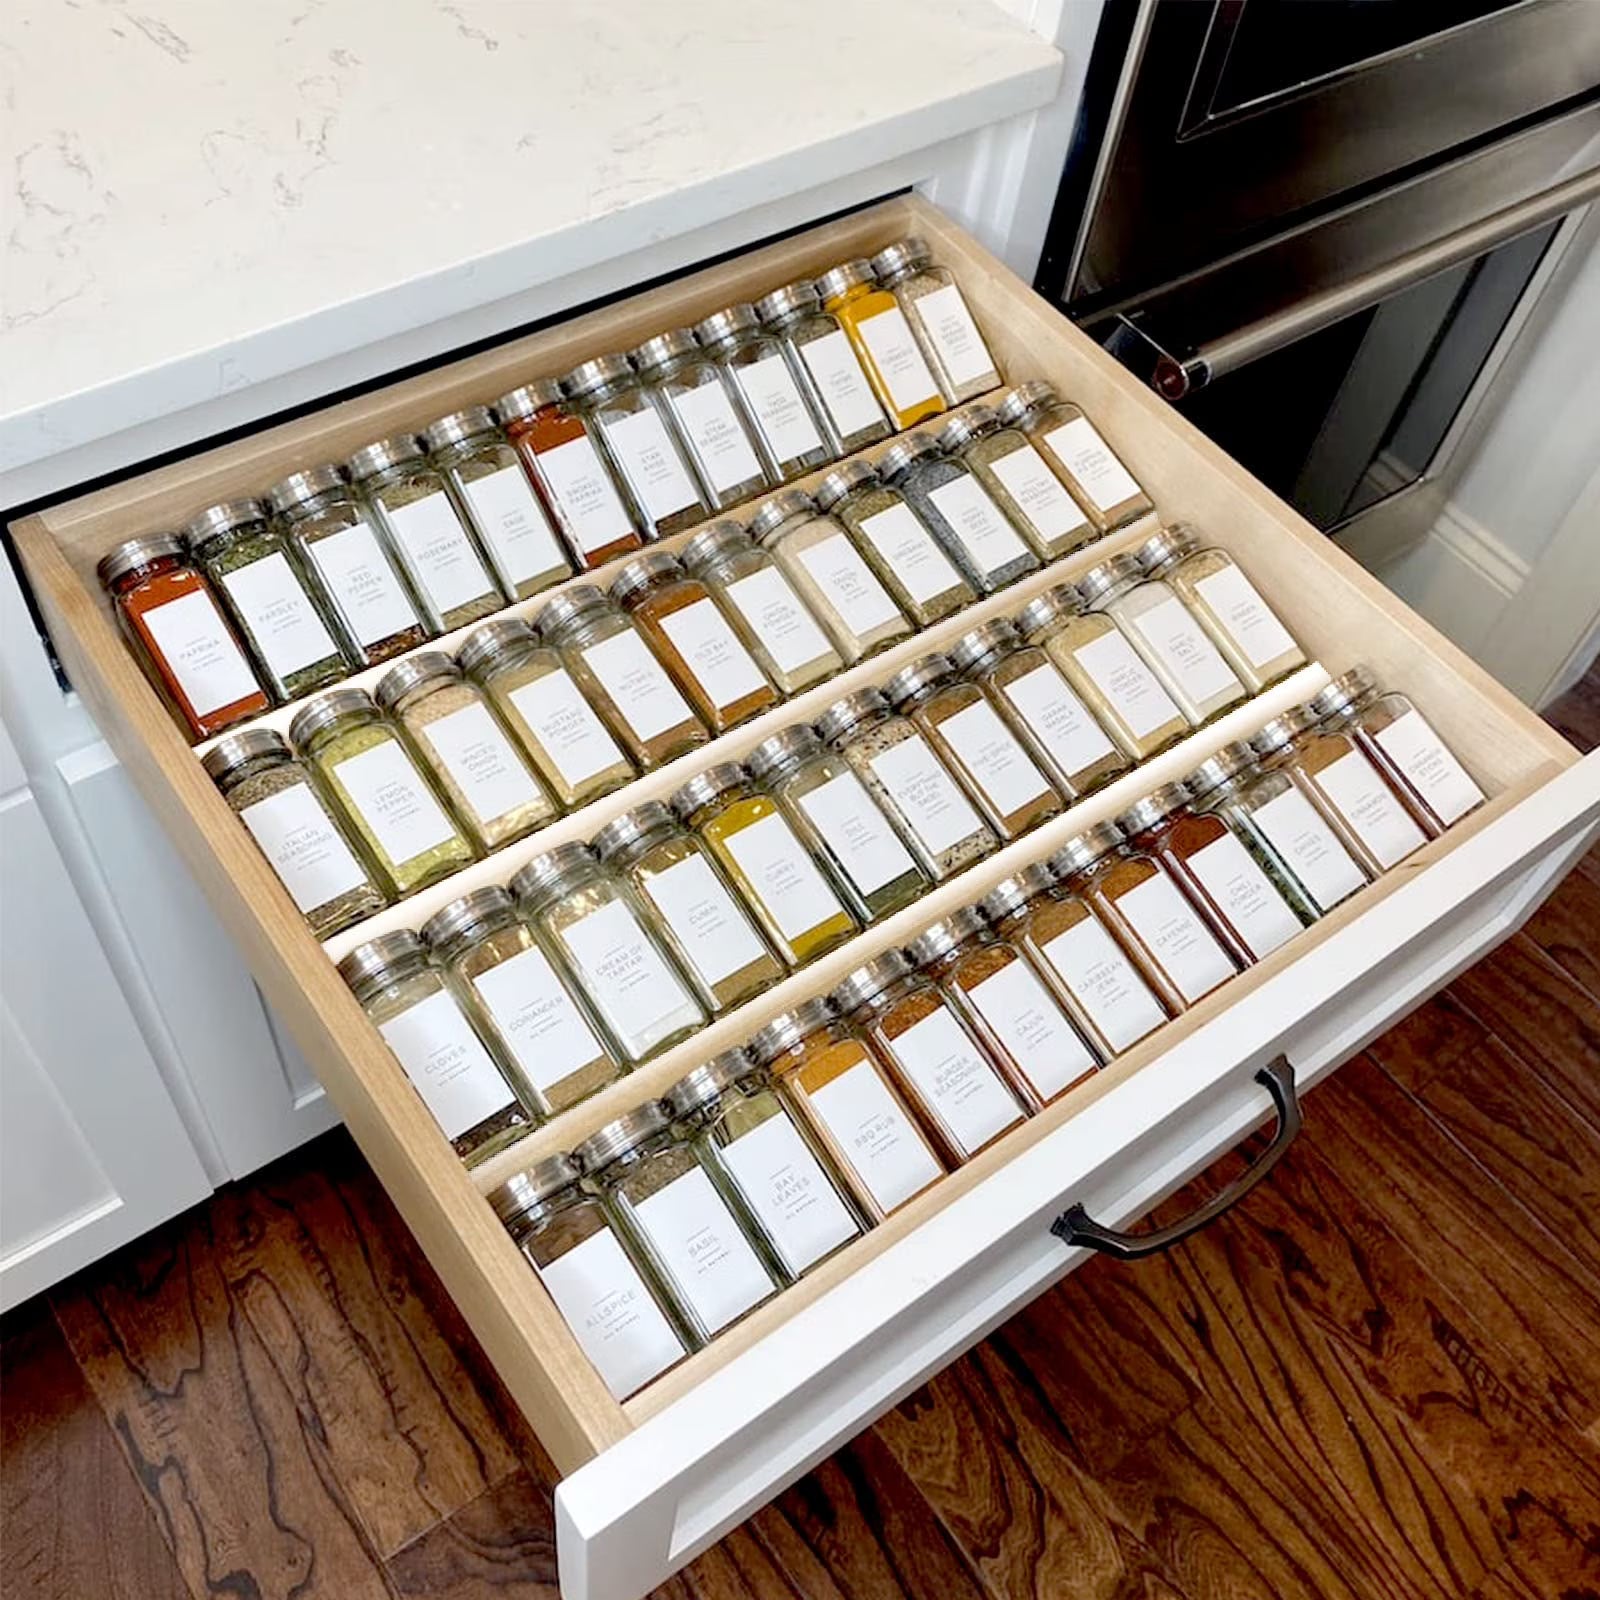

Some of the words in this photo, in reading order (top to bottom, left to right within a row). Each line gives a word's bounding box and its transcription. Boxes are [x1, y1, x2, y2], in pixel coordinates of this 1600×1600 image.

[416, 536, 464, 562] ROSEMARY
[347, 575, 383, 595] PEPPER
[351, 570, 372, 584] RED
[257, 598, 301, 624] PARSLEY
[547, 715, 587, 741] POWDER
[373, 783, 410, 807] LEMON
[376, 790, 416, 815] PEPPER
[276, 831, 334, 864] SEASONING
[281, 828, 320, 851] ITALIAN
[1154, 919, 1193, 949] CAYENNE
[594, 950, 631, 977] CREAM
[604, 953, 645, 982] TARTAR
[1075, 958, 1124, 995] CARIBBEAN
[507, 994, 566, 1033] CORIANDER
[1014, 1012, 1046, 1039] CAJUN
[423, 1044, 467, 1076] CLOVES
[933, 1056, 971, 1087] BURGER
[932, 1059, 983, 1099] SEASONING
[853, 1128, 878, 1150] BBQ
[872, 1114, 897, 1136] RUB
[769, 1175, 812, 1208] LEAVES
[773, 1172, 796, 1192] BAY
[686, 1231, 721, 1259] BASIL
[582, 1287, 638, 1331] ALLSPICE
